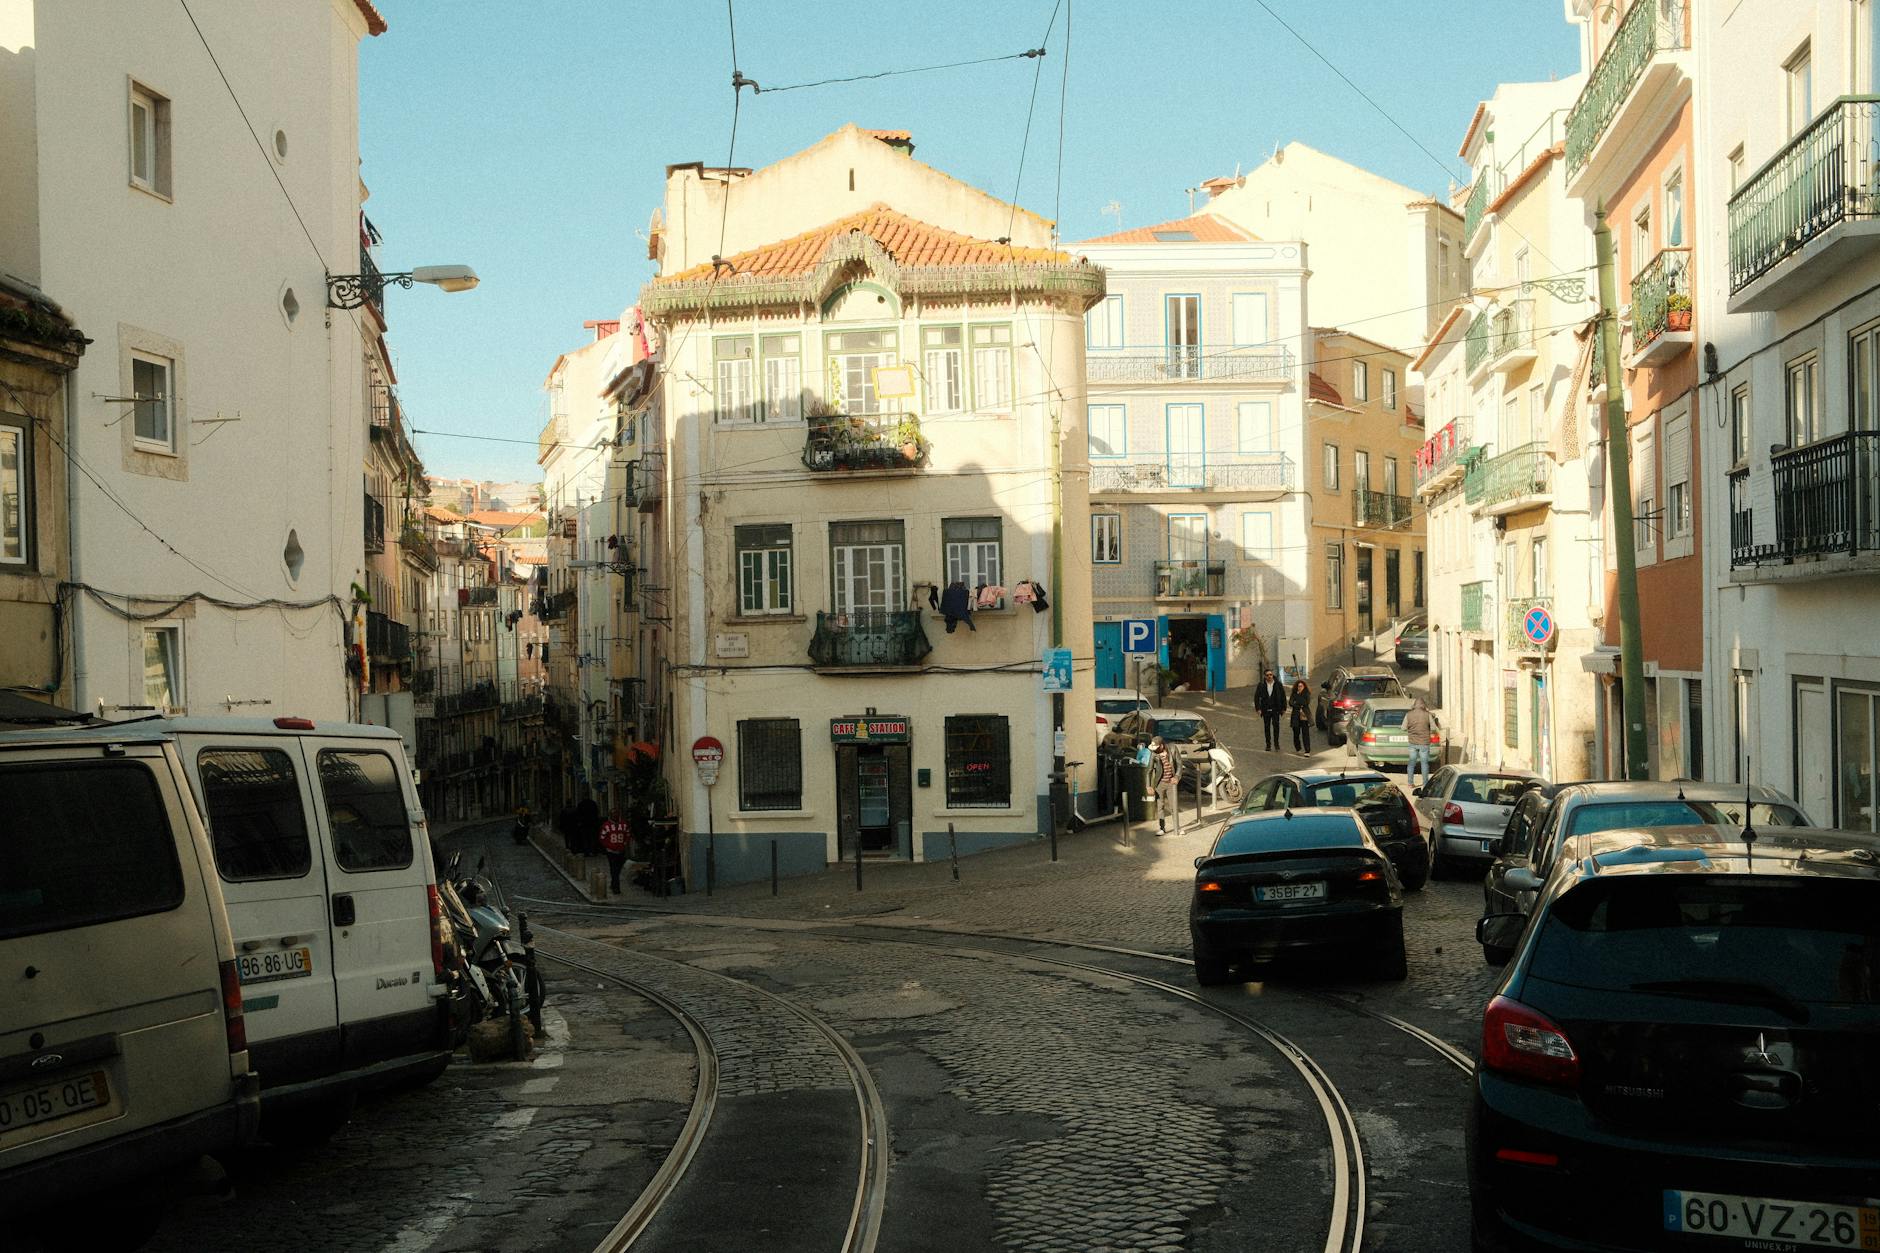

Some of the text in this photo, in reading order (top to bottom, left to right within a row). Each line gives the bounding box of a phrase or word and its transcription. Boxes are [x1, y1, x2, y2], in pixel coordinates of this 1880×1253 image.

[1128, 621, 1150, 651] P
[832, 722, 905, 735] CAFE STATION
[966, 762, 990, 771] OPEN
[610, 833, 624, 844] 89
[1605, 1084, 1664, 1099] MITSUBISHI
[1744, 1239, 1798, 1253] UNIVEX.PT
